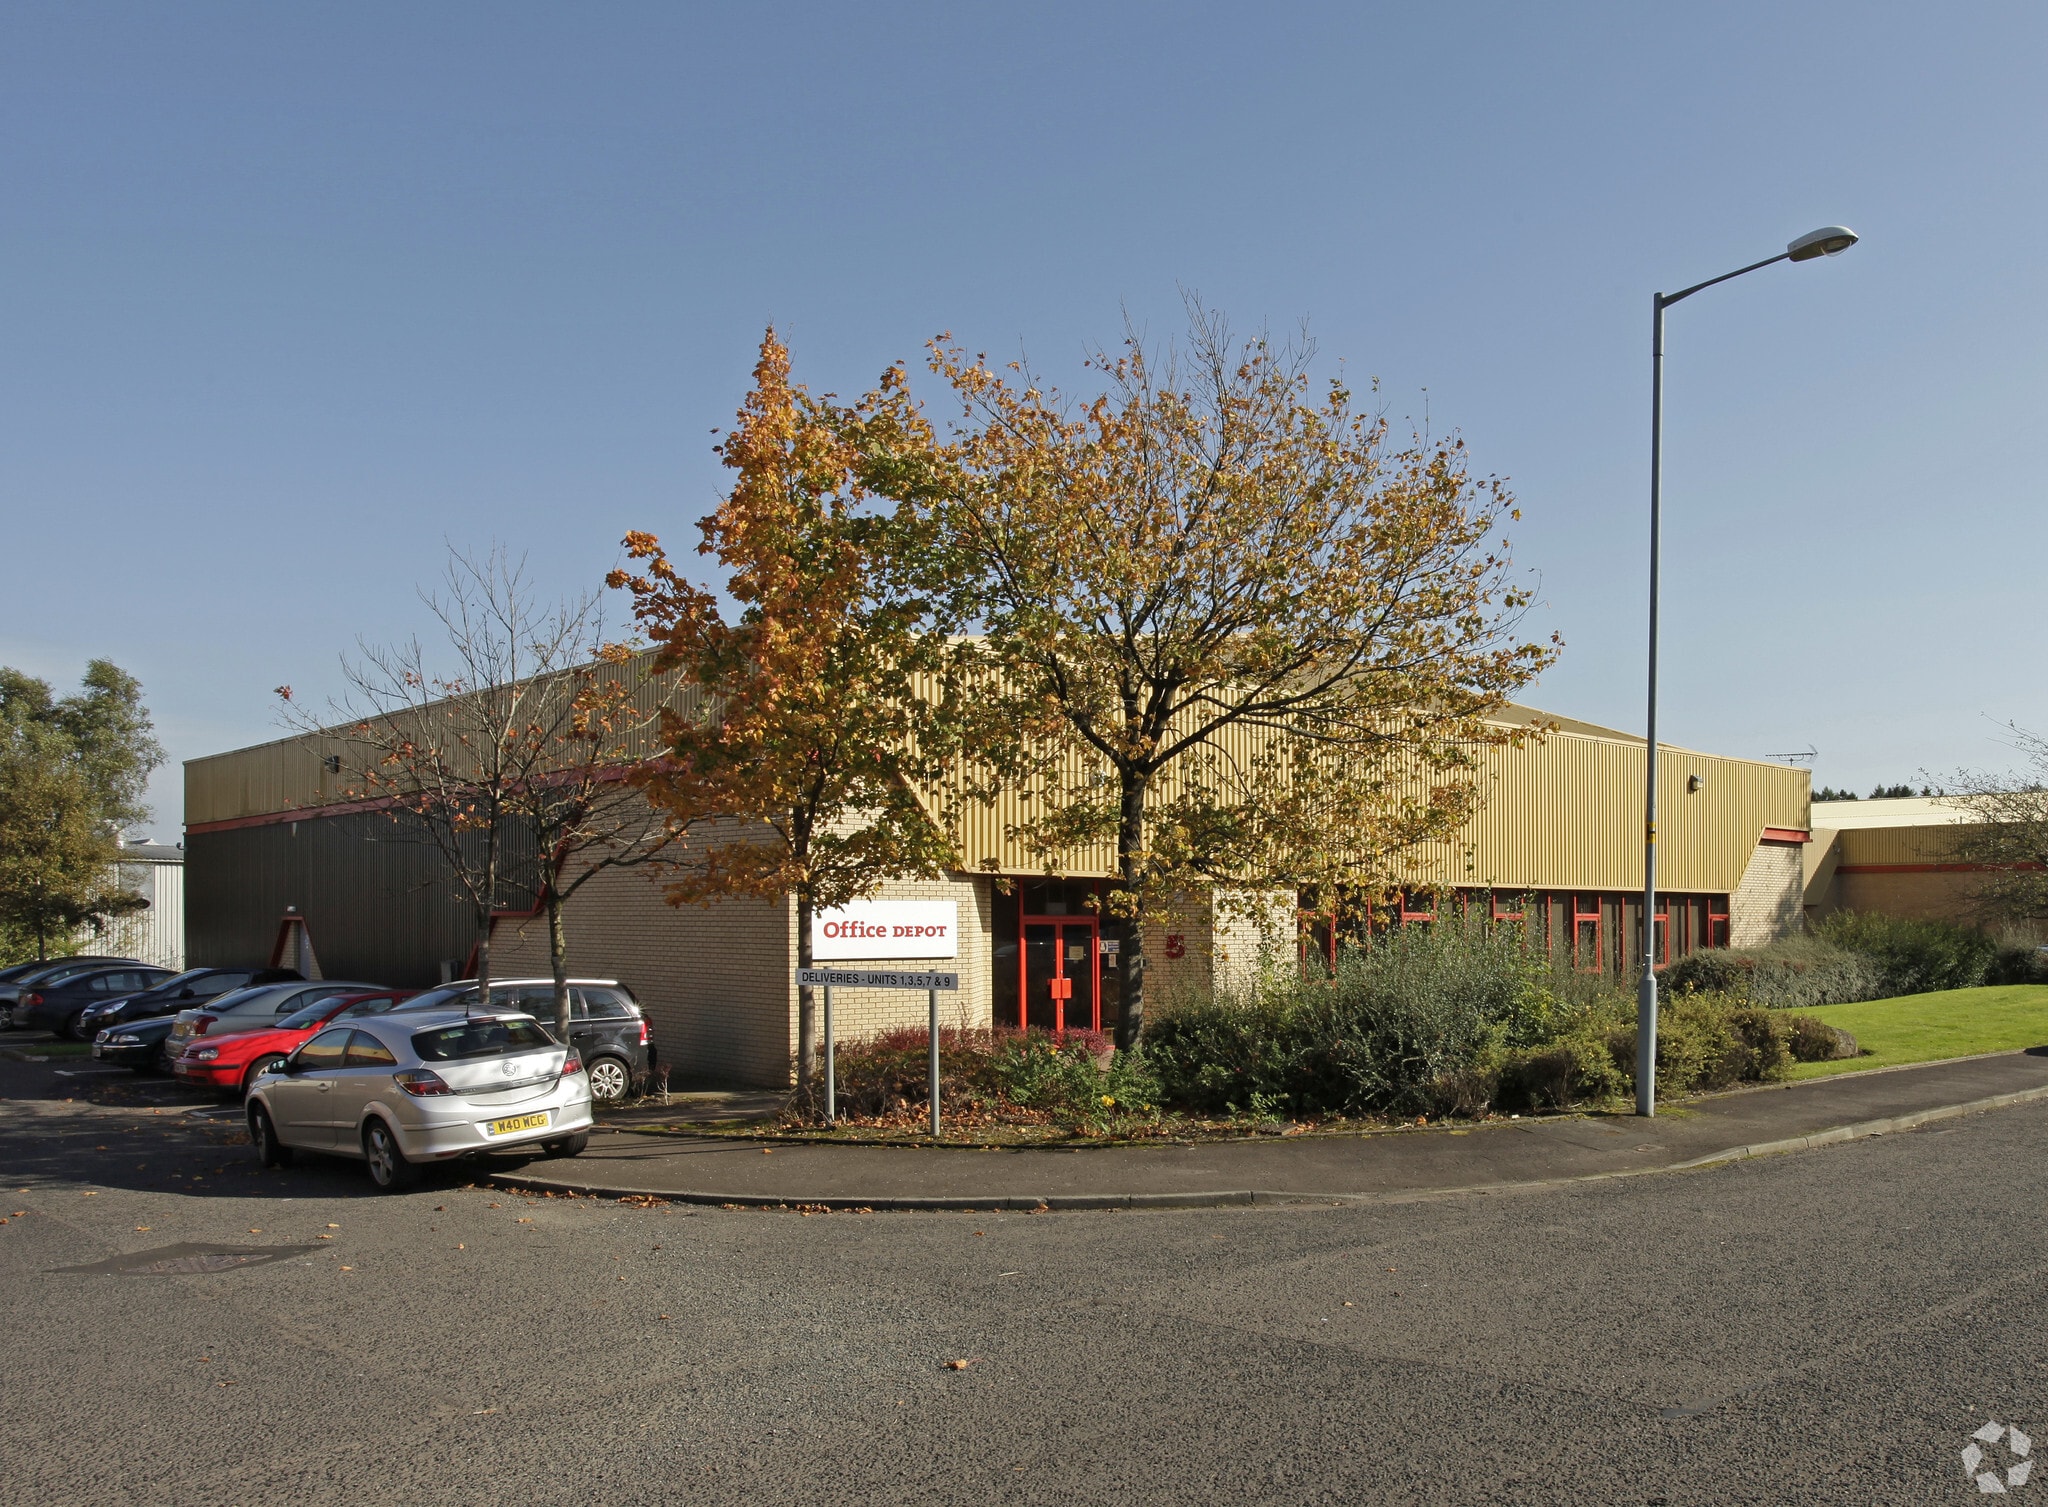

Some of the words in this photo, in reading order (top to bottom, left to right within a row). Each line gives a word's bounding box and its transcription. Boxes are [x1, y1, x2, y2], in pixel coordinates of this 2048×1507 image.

[823, 921, 887, 938] Office
[893, 926, 947, 937] DEPOT
[1166, 935, 1185, 959] 5
[802, 972, 859, 984] DELIVERIES
[867, 975, 897, 985] UNITS
[900, 976, 932, 987] 1,3,5,7
[934, 977, 942, 987] &
[944, 977, 950, 987] 9
